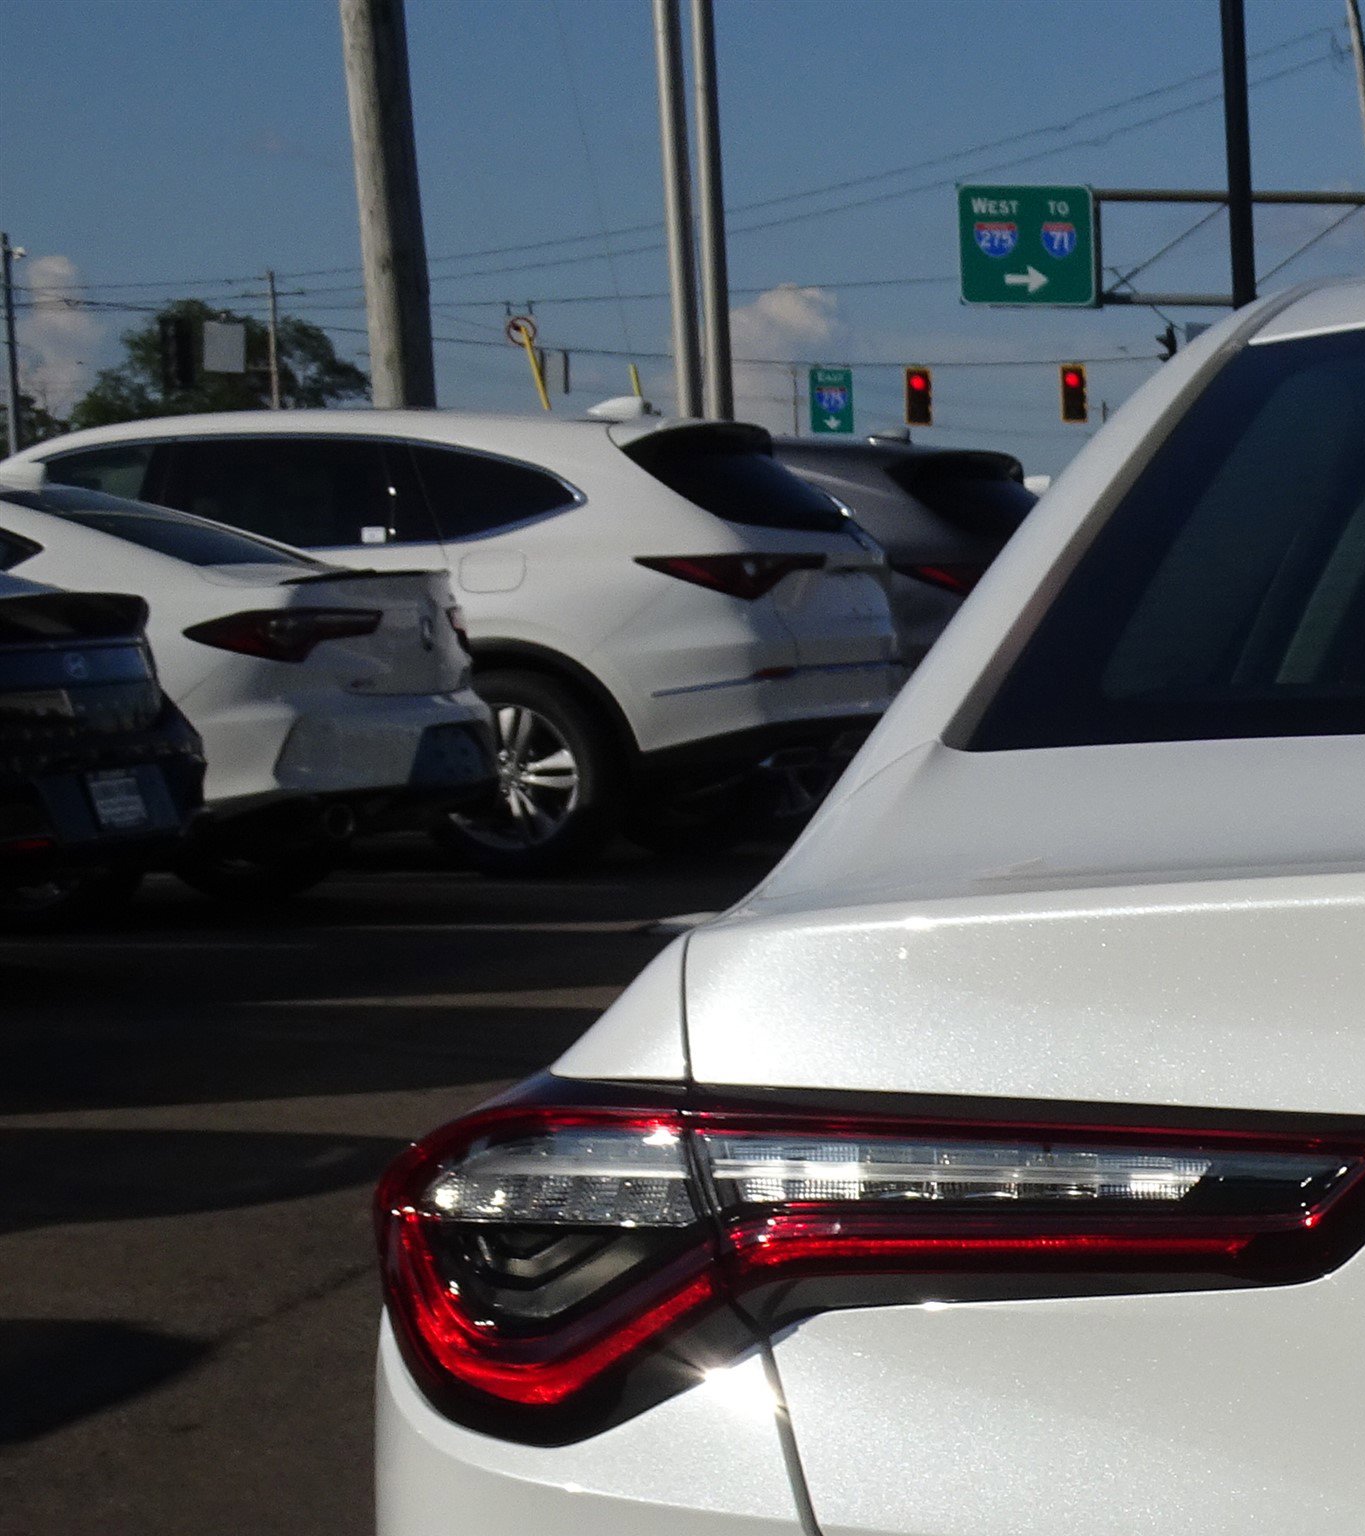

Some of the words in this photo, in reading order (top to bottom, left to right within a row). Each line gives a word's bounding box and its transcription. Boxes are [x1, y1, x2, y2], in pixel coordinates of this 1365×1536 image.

[972, 197, 1019, 215] WEST
[1047, 200, 1069, 216] TO
[980, 230, 1013, 248] 275
[1051, 232, 1069, 250] 71
